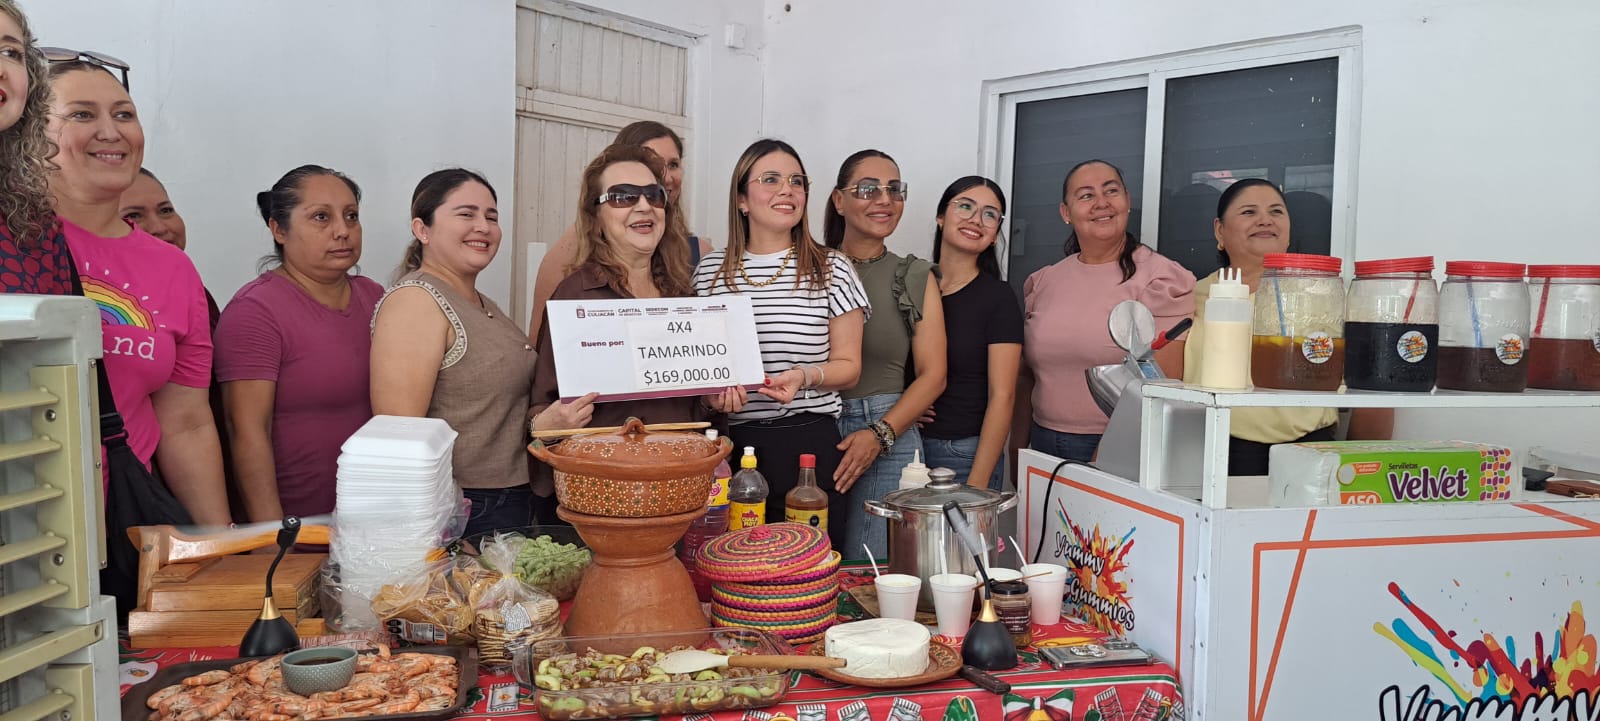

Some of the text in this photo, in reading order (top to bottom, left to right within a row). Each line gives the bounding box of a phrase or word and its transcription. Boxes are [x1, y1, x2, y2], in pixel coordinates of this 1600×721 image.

[667, 321, 692, 333] 4X4
[103, 336, 155, 360] nd
[609, 340, 625, 348] por:
[637, 343, 727, 359] TAMARINDO
[644, 367, 731, 386] $169,000.00
[1388, 463, 1418, 471] Servilletas
[1388, 465, 1469, 502] Velvet
[1055, 531, 1105, 577] Yummy
